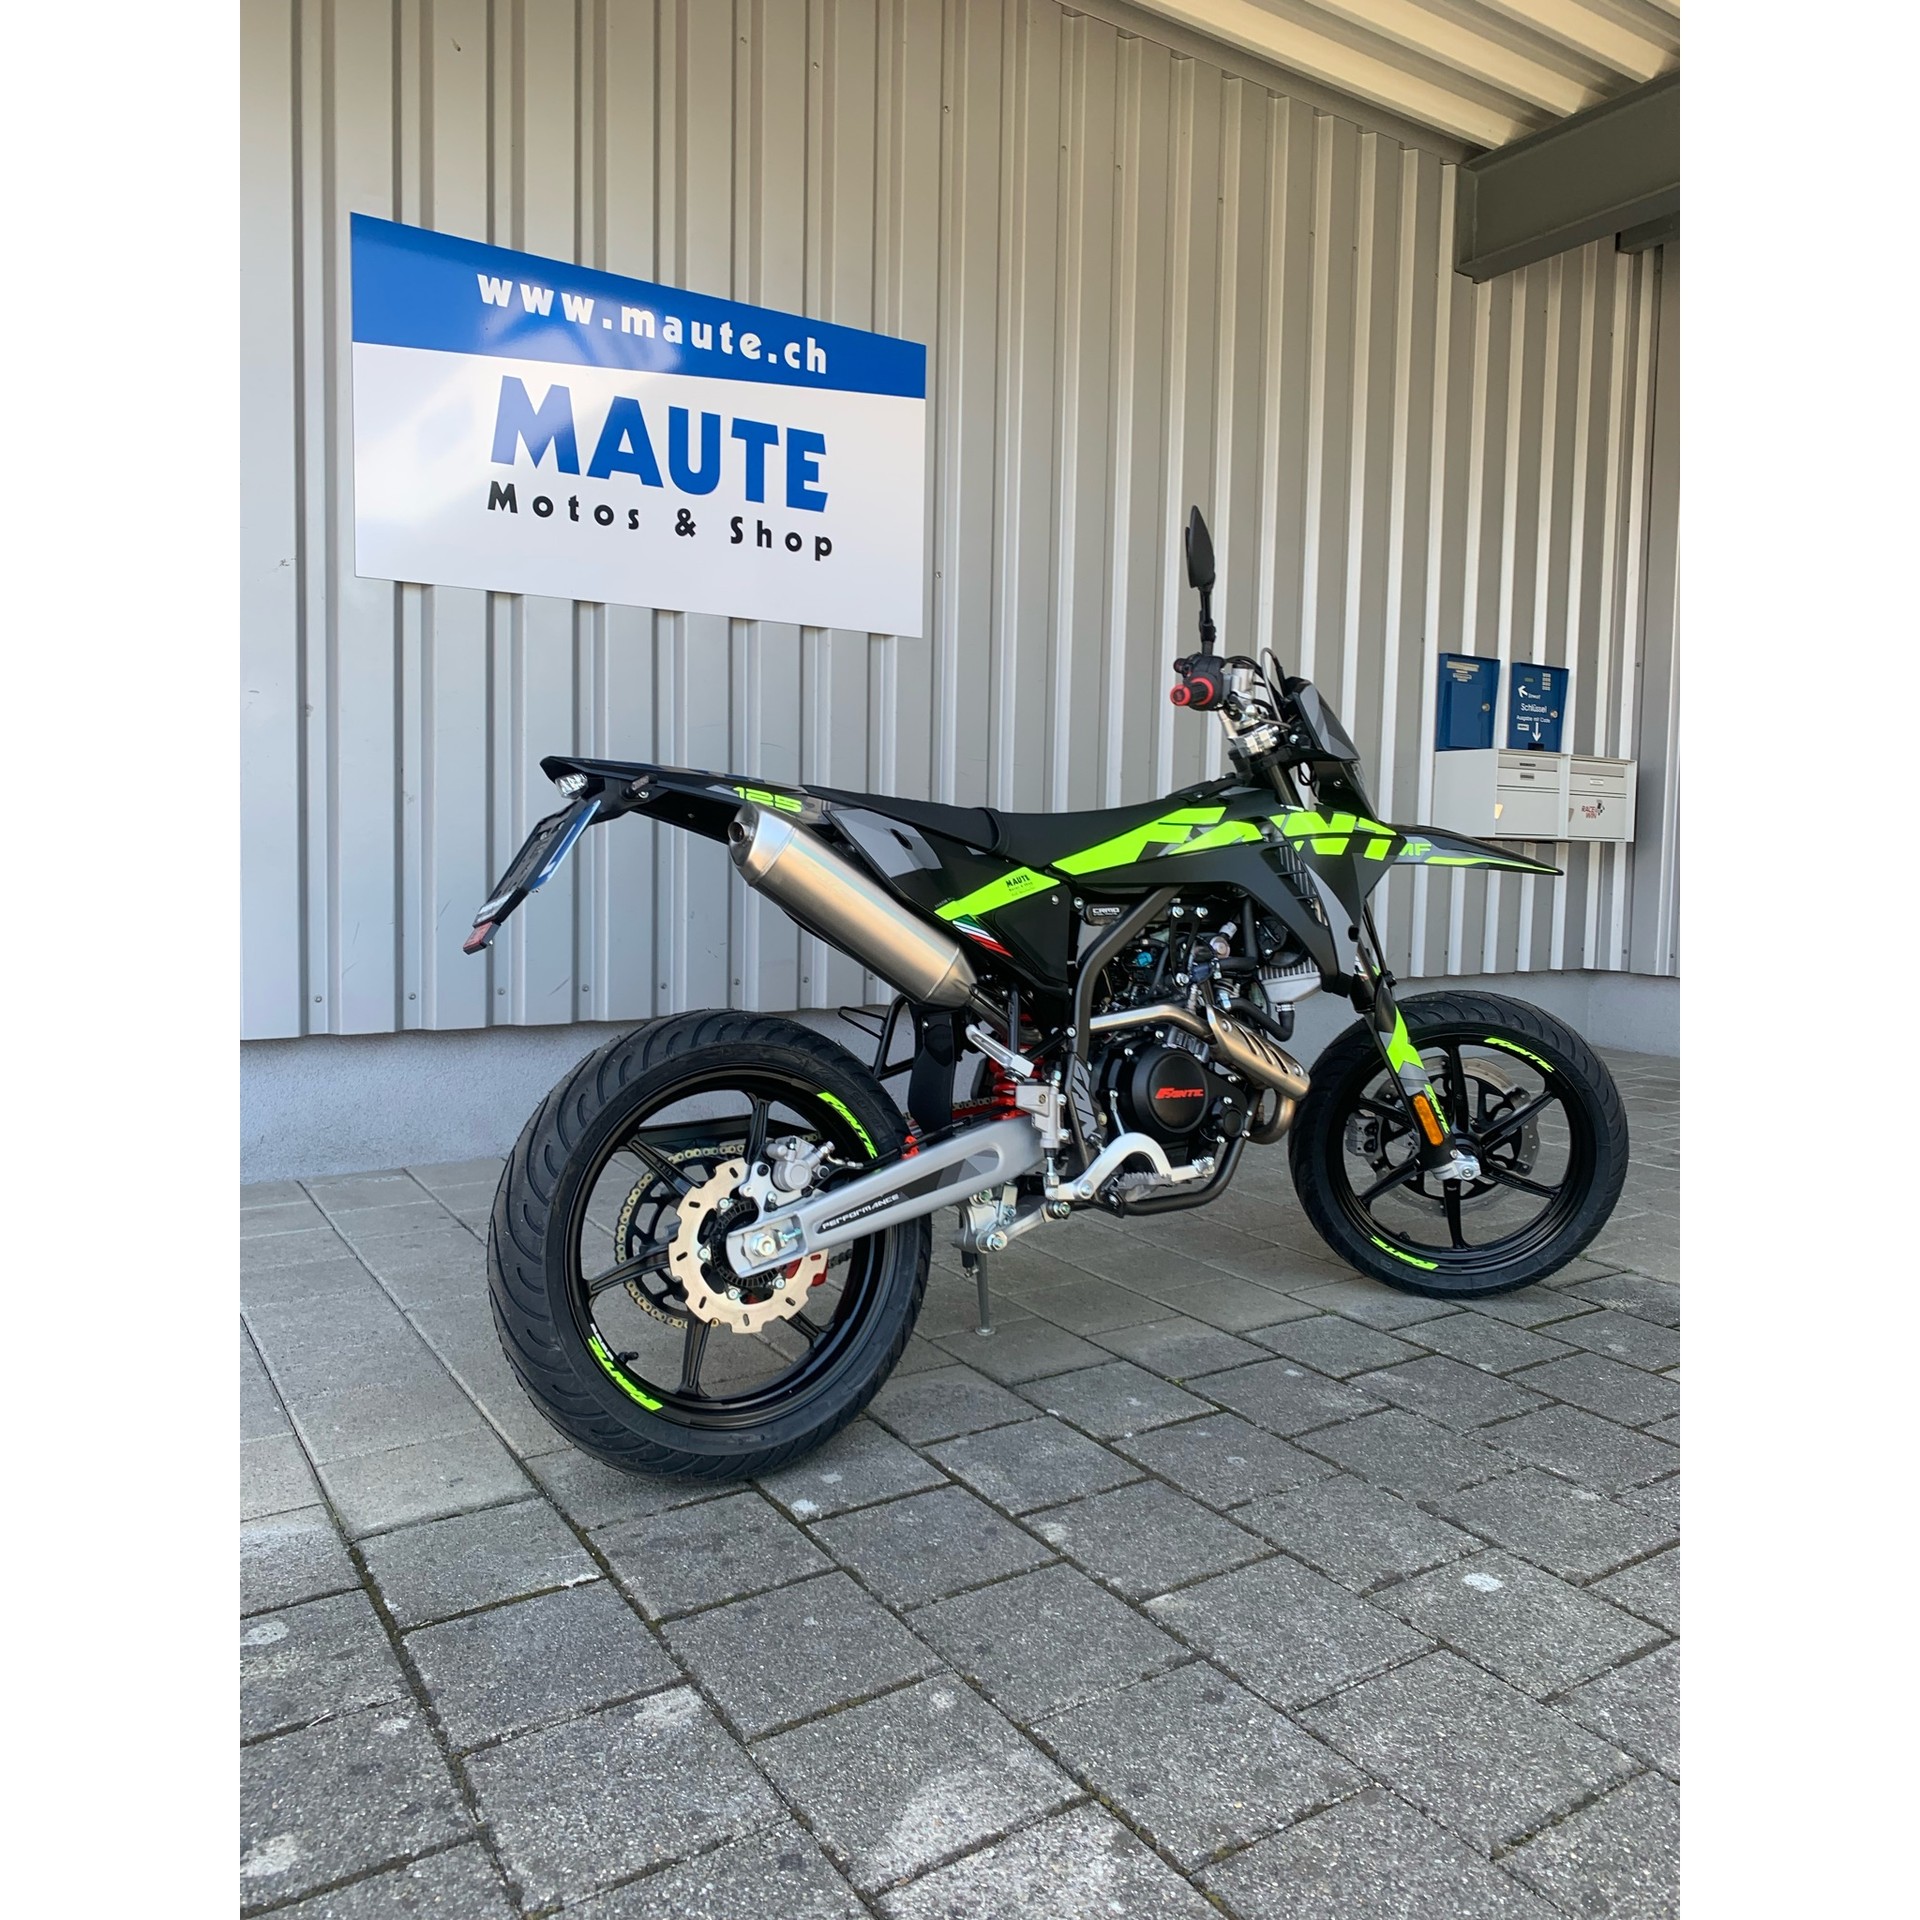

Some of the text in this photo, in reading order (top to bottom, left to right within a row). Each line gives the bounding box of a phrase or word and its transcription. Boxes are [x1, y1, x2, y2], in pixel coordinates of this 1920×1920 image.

[477, 273, 827, 374] www.maute.ch
[491, 375, 829, 513] MAUTE
[487, 481, 833, 561] Motos & Shop
[1520, 703, 1548, 713] Schlüssel
[733, 786, 802, 813] 125
[1155, 1087, 1204, 1100] FANTIC
[822, 1193, 900, 1230] PERFORMANCE
